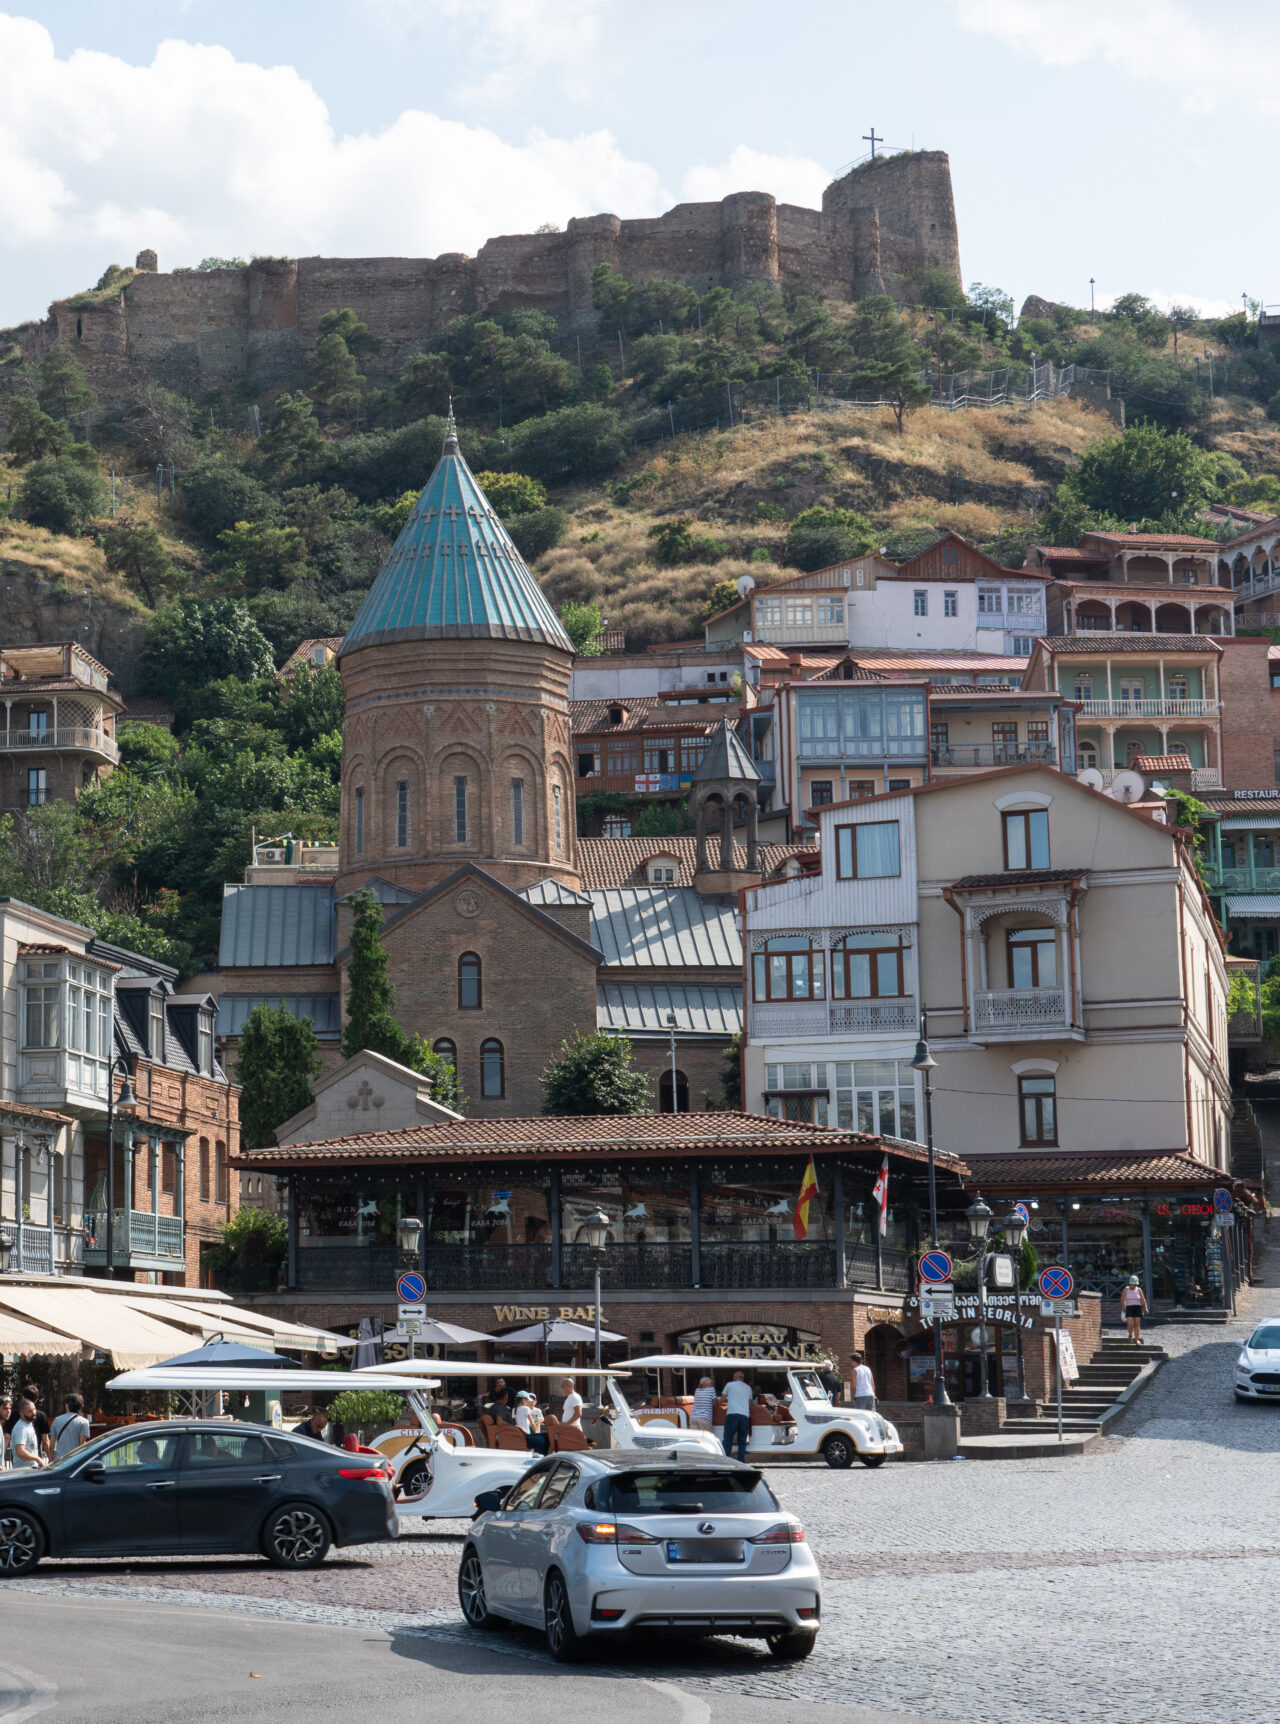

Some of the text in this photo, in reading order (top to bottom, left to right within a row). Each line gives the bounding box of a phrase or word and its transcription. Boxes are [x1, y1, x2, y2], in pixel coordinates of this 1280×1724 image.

[493, 1305, 609, 1324] WINE BAR
[962, 1308, 976, 1319] IN
[683, 1343, 806, 1361] MUKHRANI
